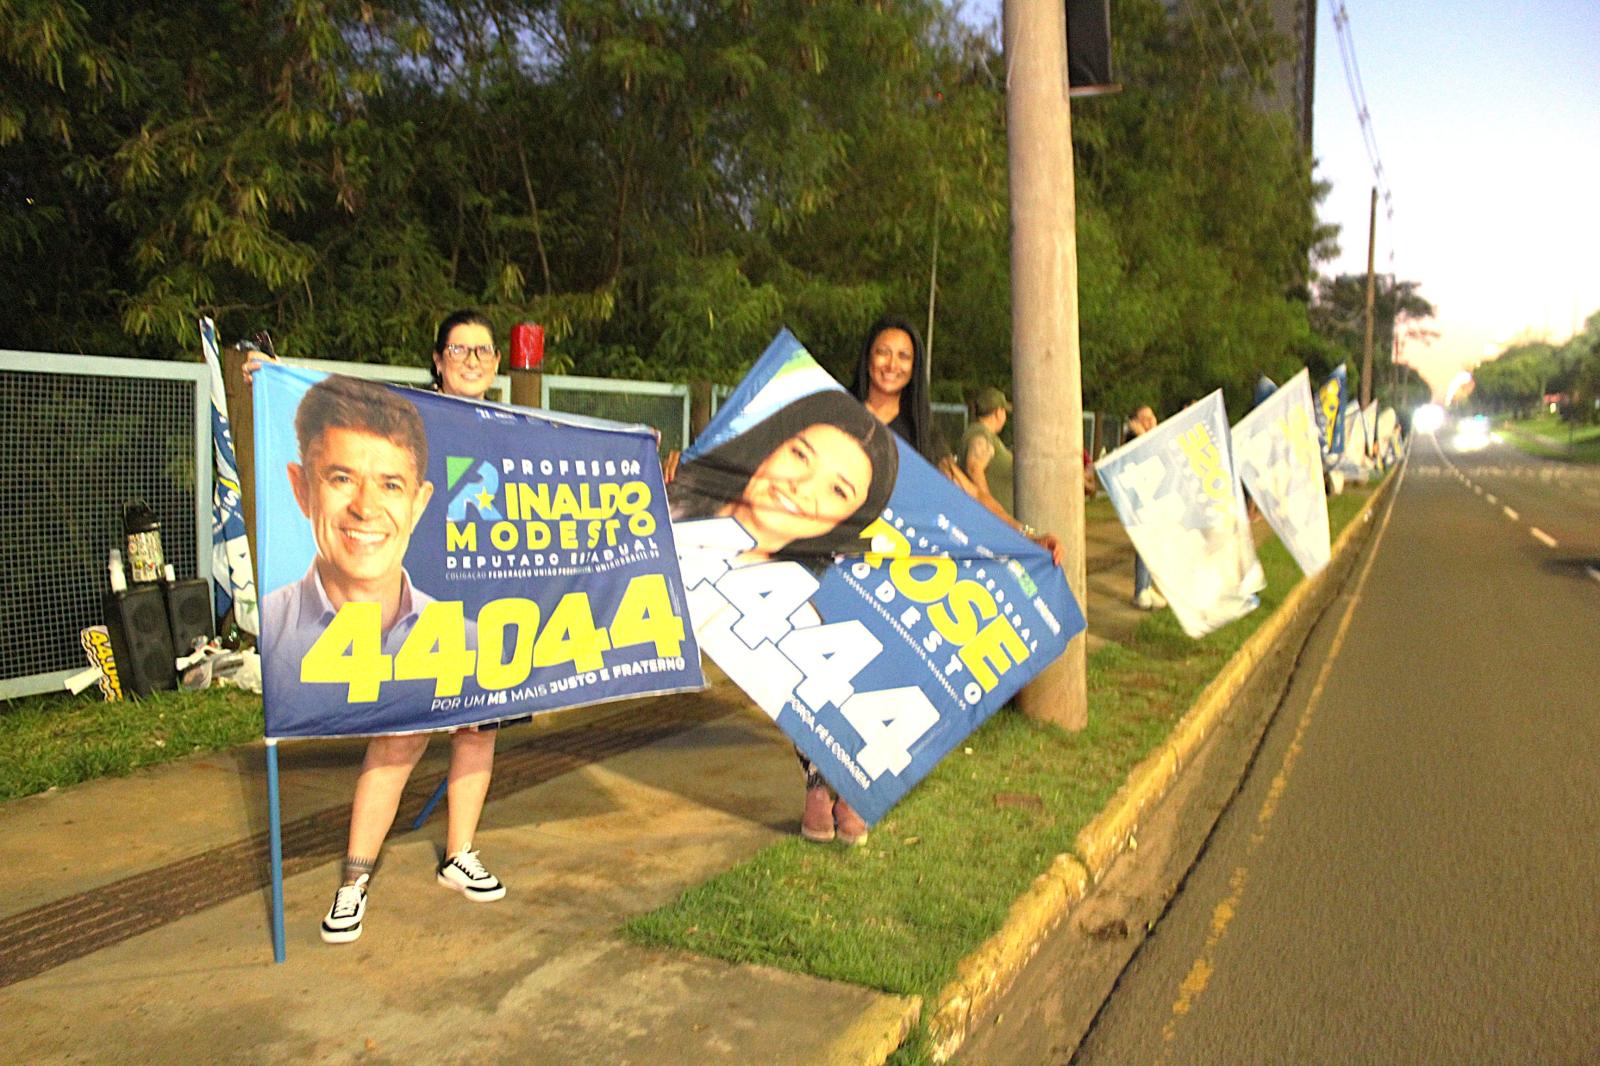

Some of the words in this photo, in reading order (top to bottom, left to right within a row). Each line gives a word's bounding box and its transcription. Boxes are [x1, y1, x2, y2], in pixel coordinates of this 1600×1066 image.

[502, 458, 641, 476] PROFESSOR
[446, 510, 657, 552] MODESTO
[446, 552, 560, 569] DEPUTADO
[836, 554, 982, 705] ODESTO
[976, 568, 1038, 653] FEDERAL
[300, 574, 685, 703] 44044
[431, 697, 460, 711] POR
[464, 695, 485, 708] UM
[511, 684, 547, 702] MAIS
[549, 671, 597, 694] JUSTO
[600, 667, 610, 682] E
[613, 657, 686, 678] FRATERNO
[831, 742, 871, 790] CORAGEM
